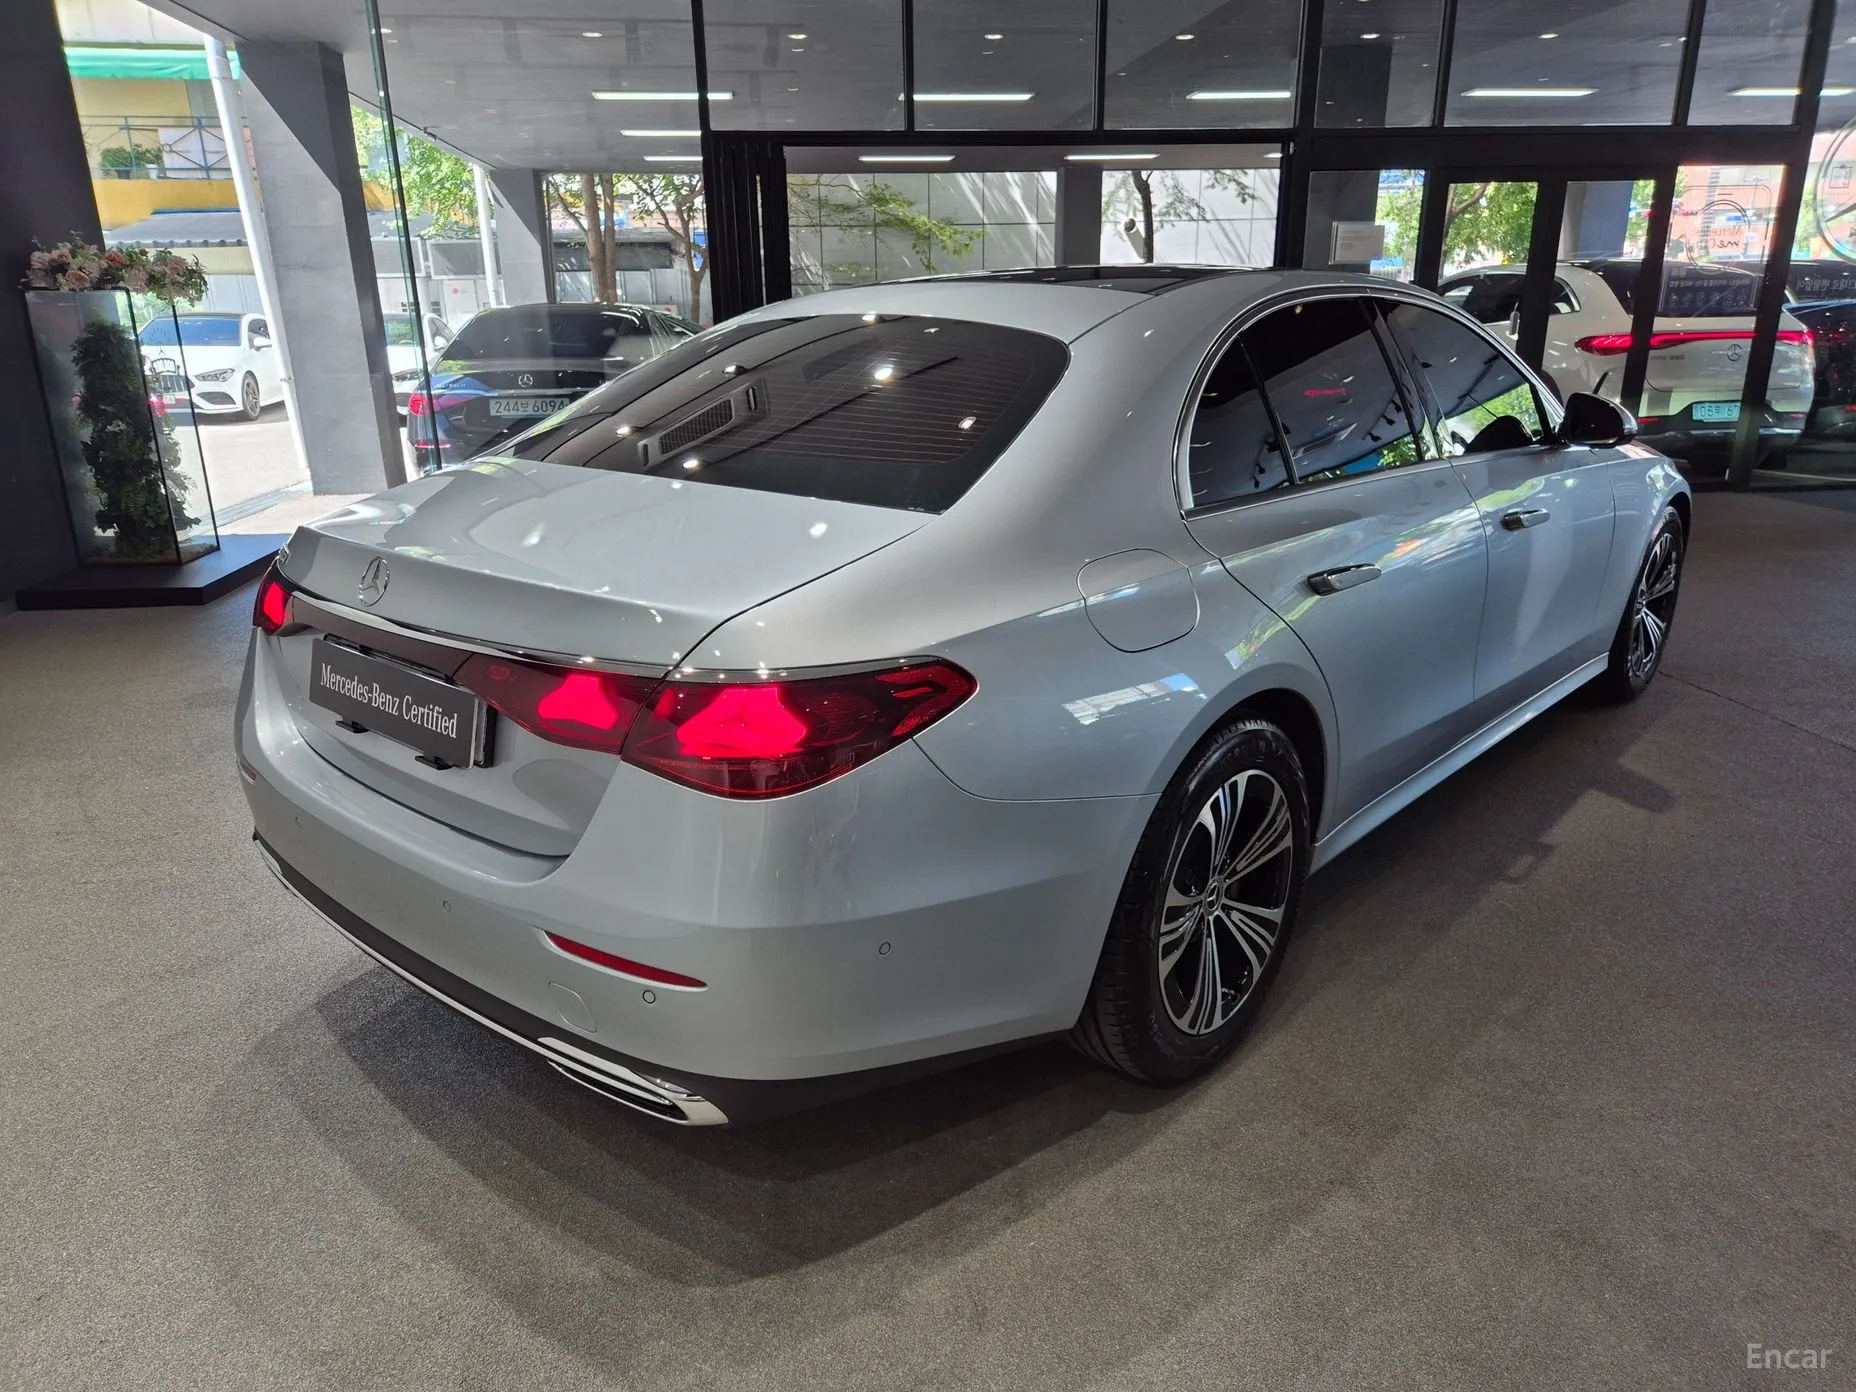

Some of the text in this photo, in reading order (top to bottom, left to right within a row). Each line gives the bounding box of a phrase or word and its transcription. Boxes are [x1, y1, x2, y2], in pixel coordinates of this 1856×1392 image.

[532, 400, 565, 413] 6094
[320, 663, 457, 738] Mercedes-Benz Certified
